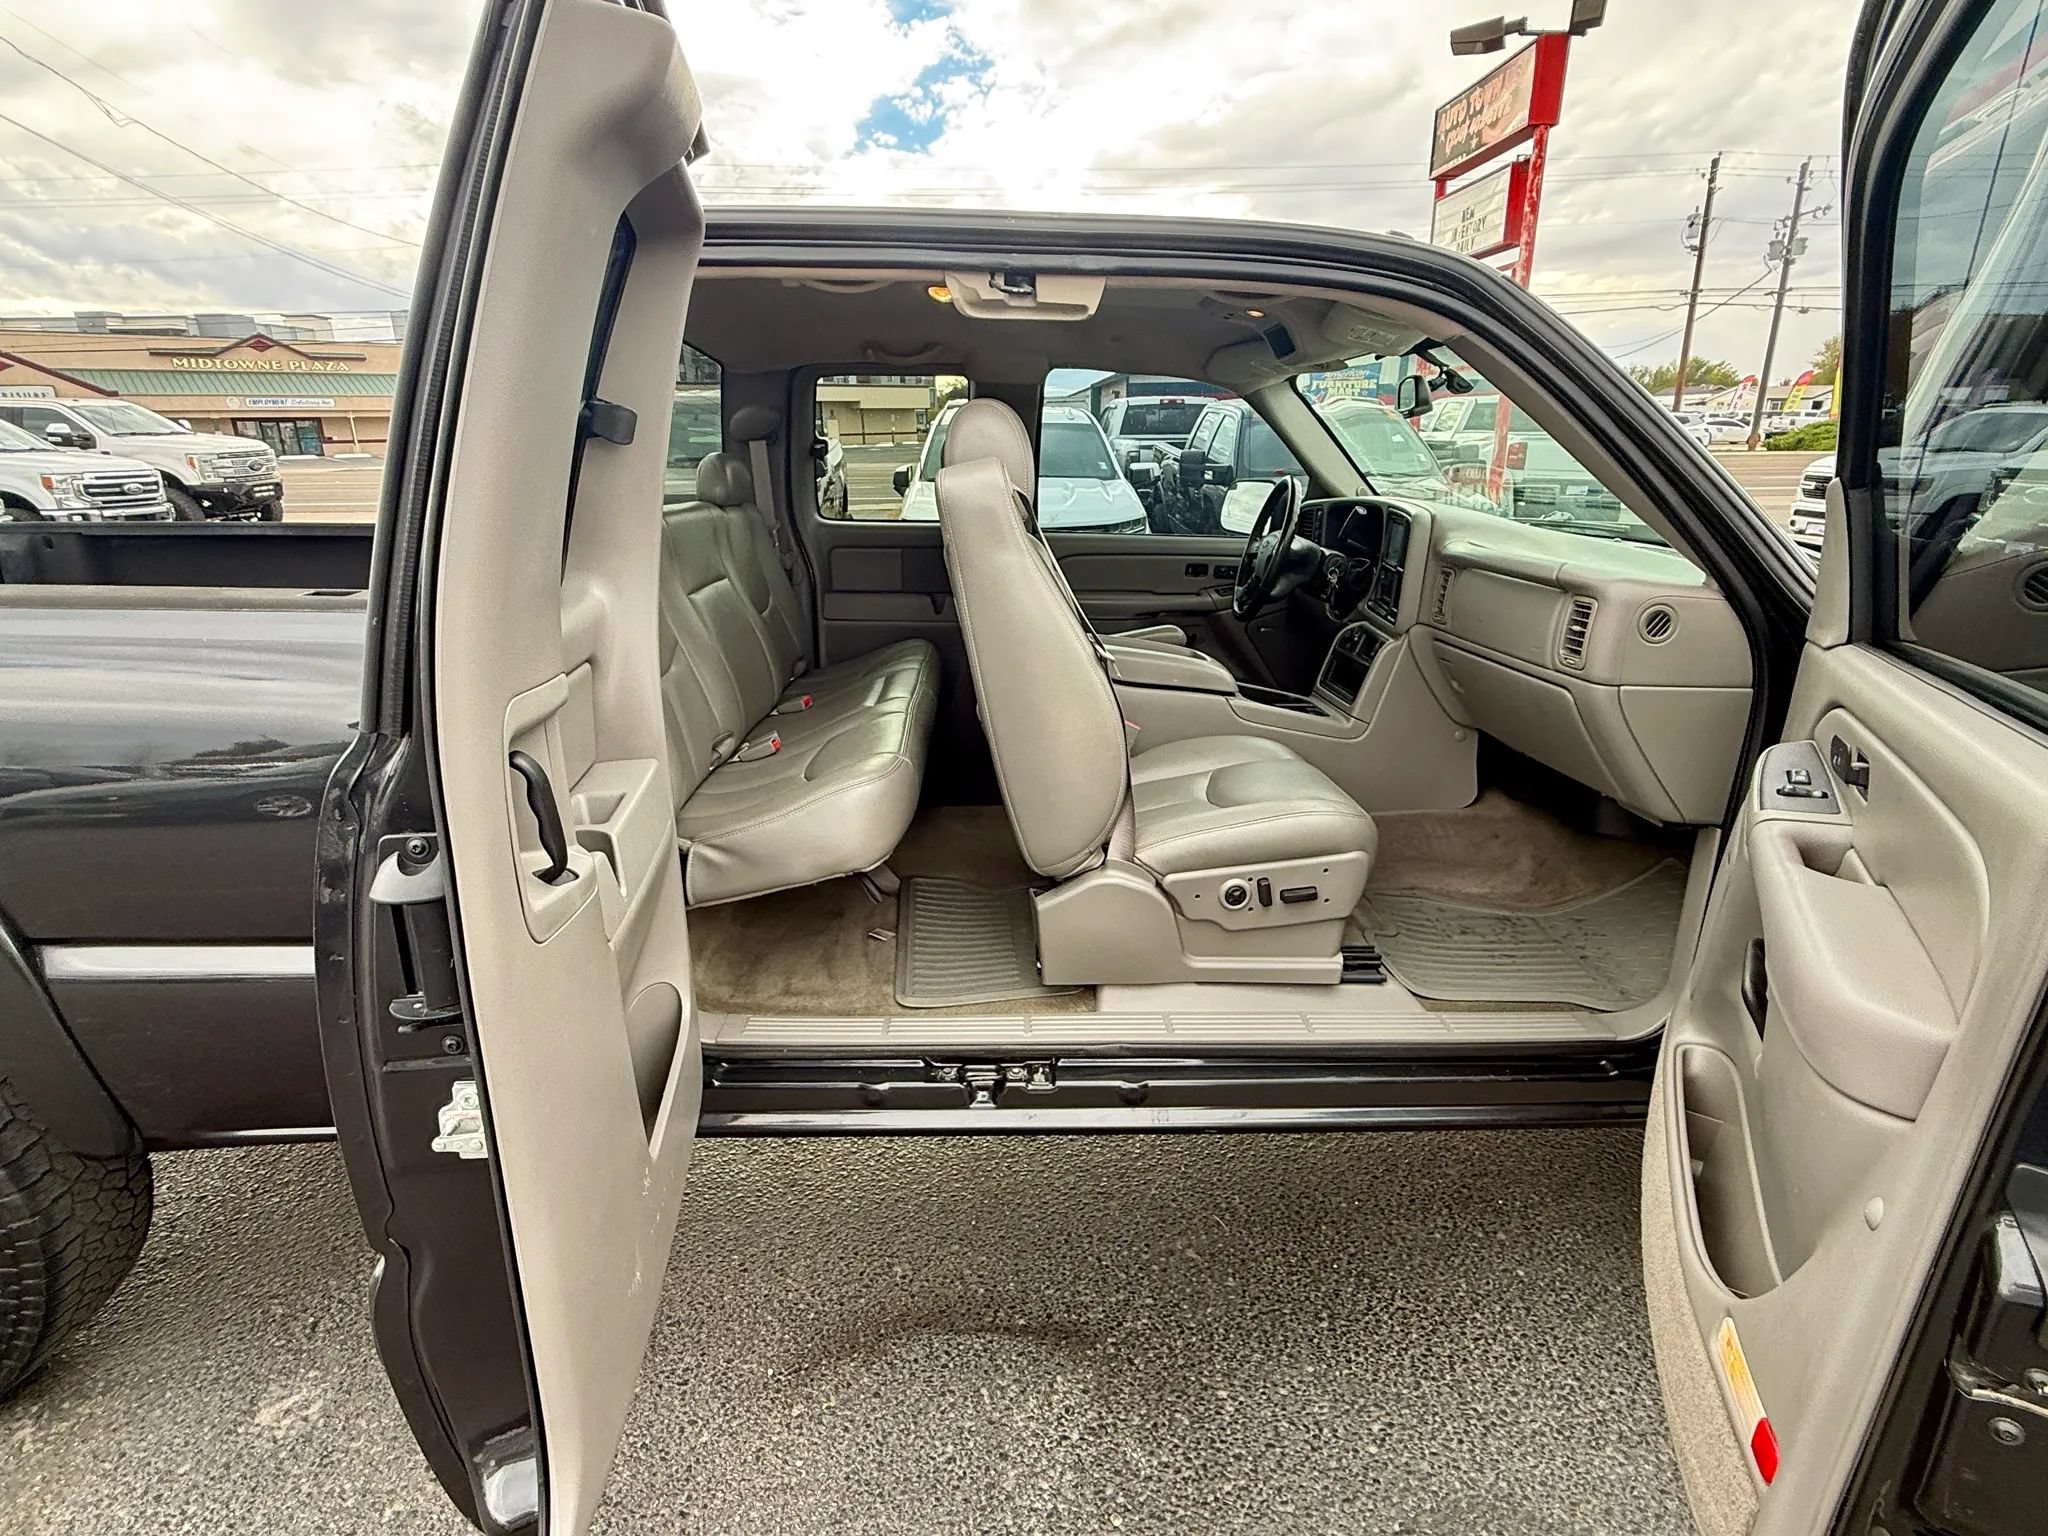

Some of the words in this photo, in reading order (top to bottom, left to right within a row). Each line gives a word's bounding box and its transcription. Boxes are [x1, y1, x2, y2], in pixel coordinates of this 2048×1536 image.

[172, 358, 283, 371] MIDTOWNE
[289, 360, 350, 371] PLAZA
[1312, 379, 1377, 389] FURNITURE
[1328, 387, 1361, 397] MART
